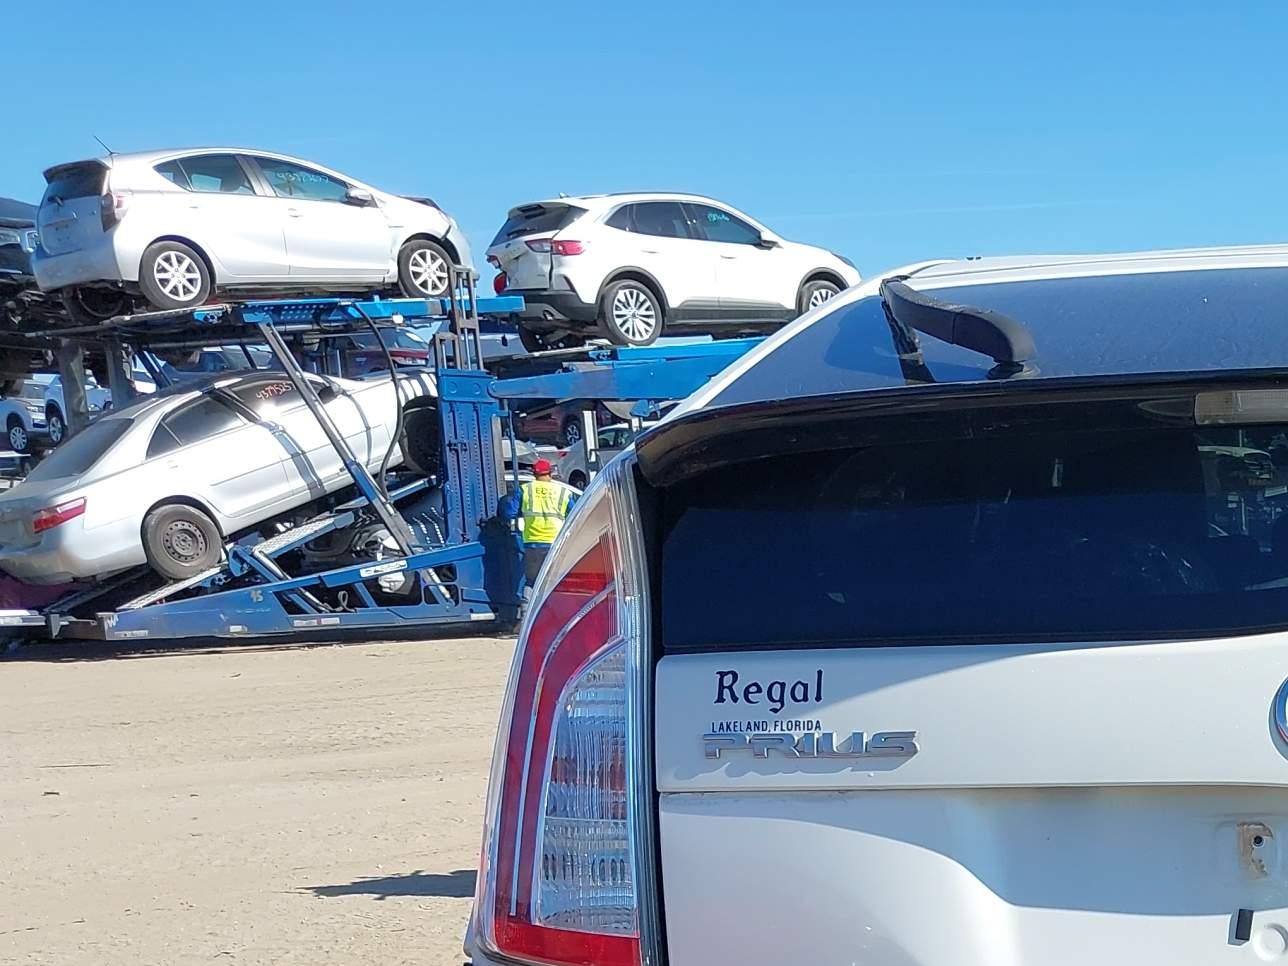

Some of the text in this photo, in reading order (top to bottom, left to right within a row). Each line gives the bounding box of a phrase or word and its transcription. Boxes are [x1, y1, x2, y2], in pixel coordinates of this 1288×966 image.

[713, 668, 823, 714] Regal
[711, 719, 822, 733] LAKELAND, FLORIDA
[703, 731, 919, 759] PRIUS
